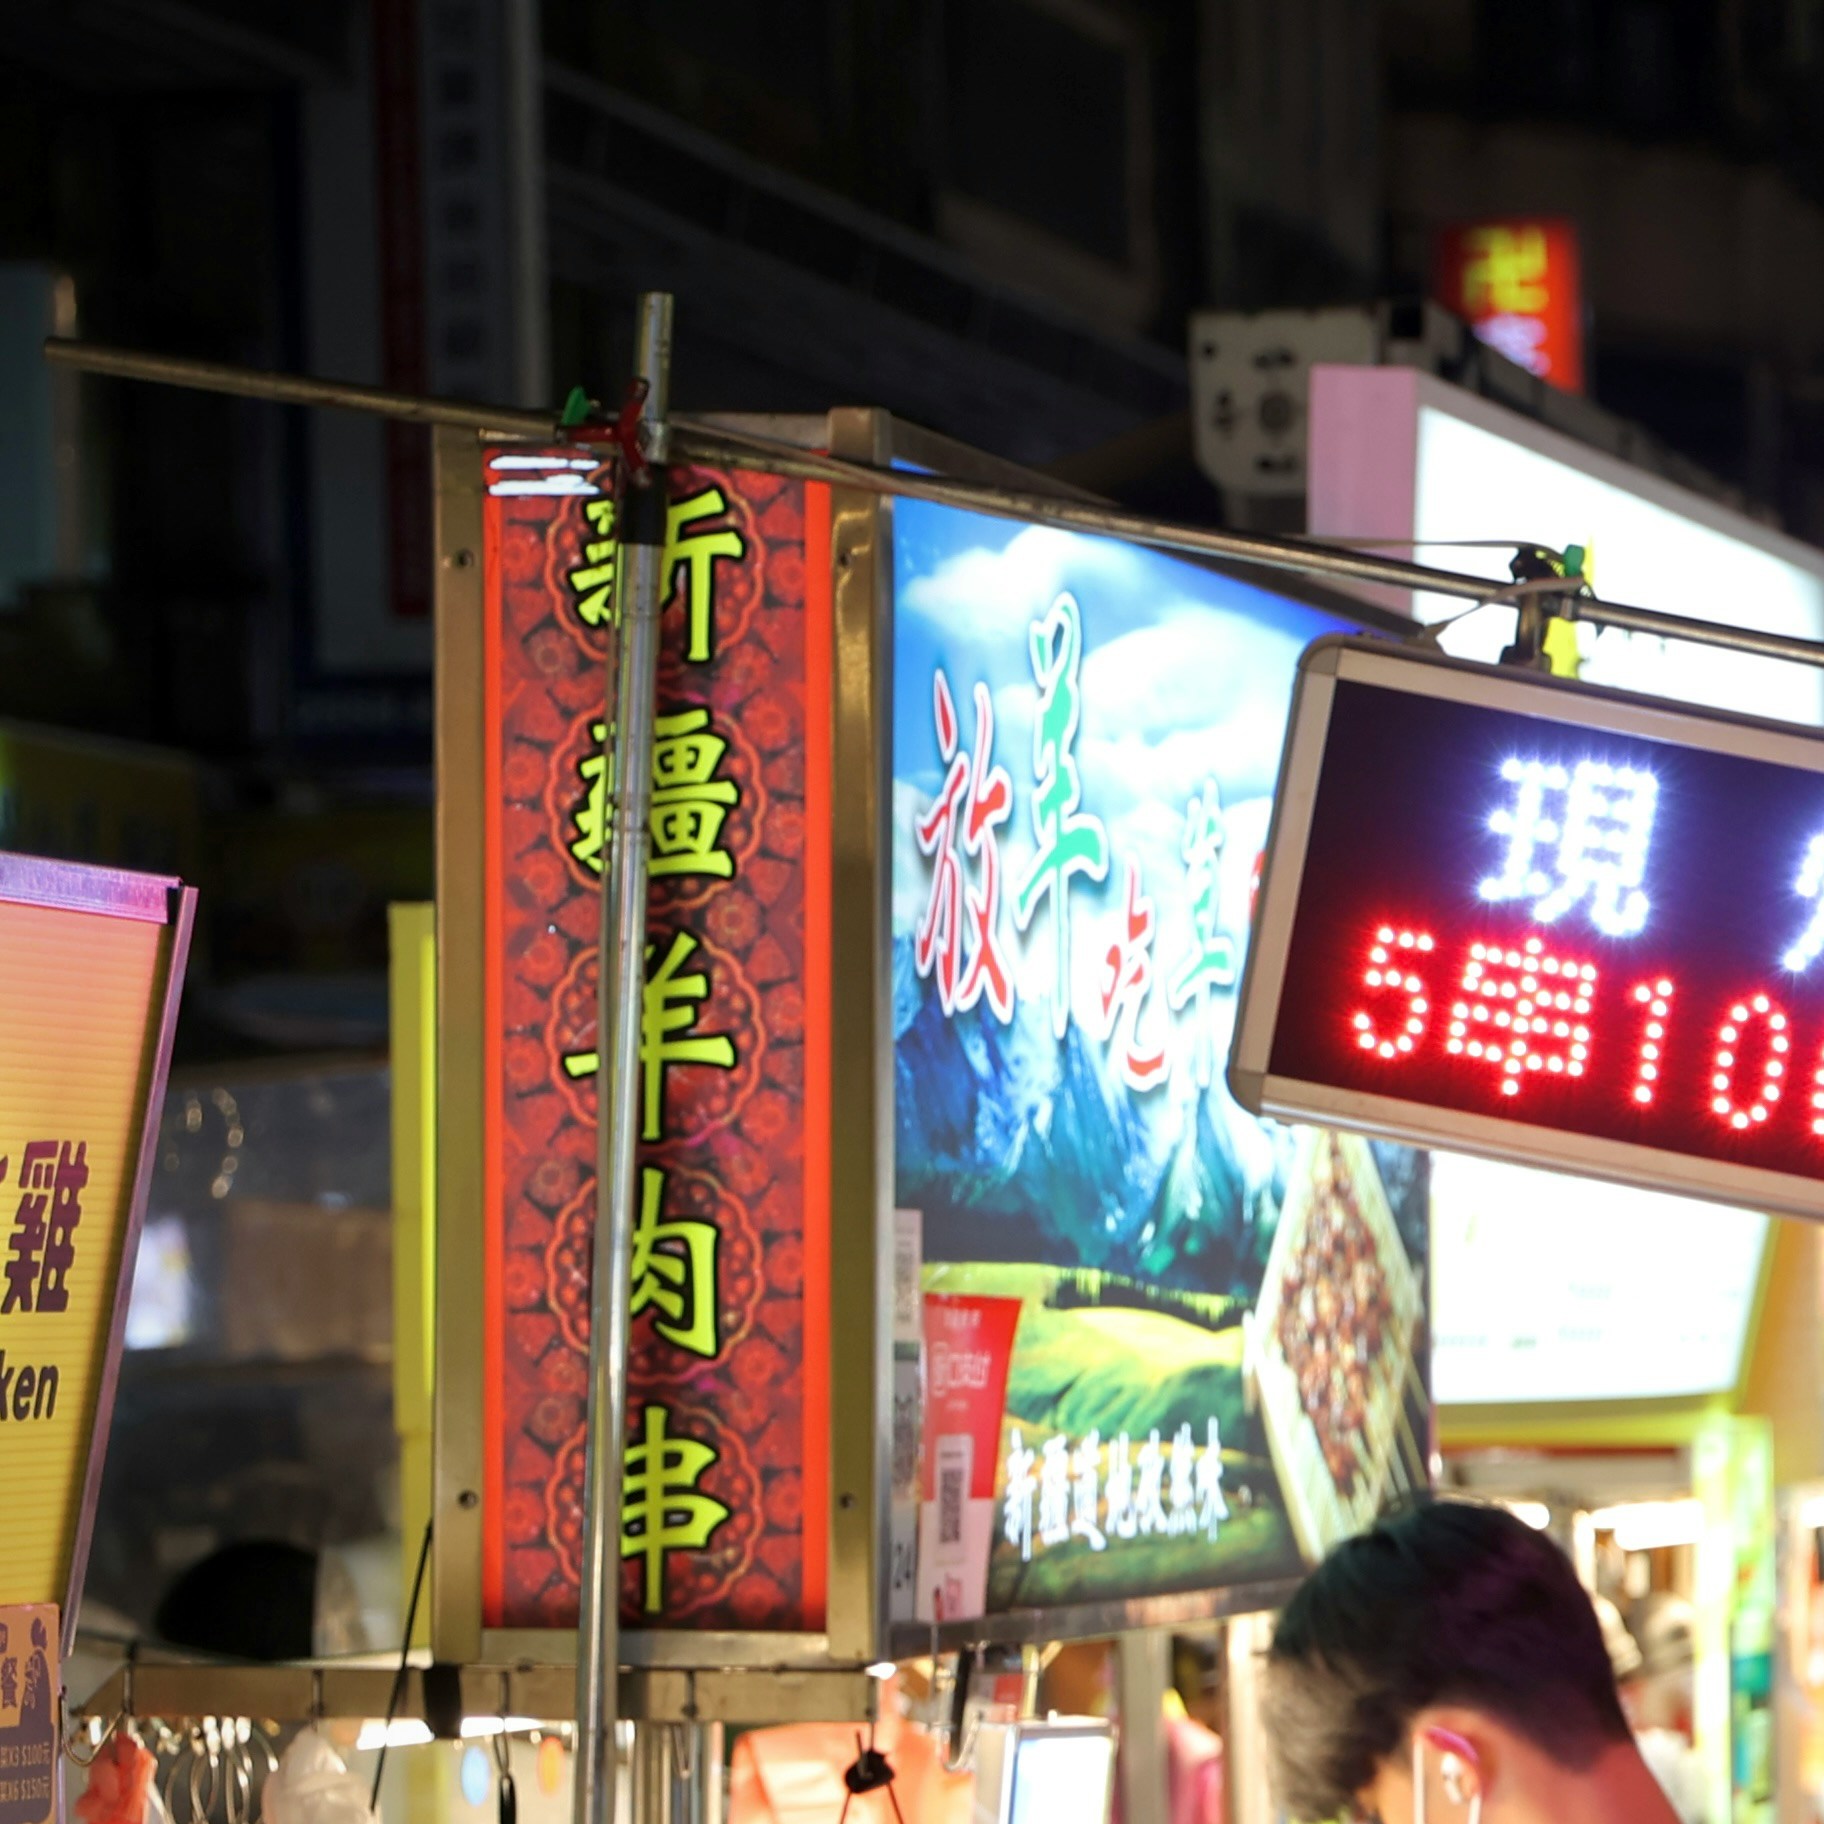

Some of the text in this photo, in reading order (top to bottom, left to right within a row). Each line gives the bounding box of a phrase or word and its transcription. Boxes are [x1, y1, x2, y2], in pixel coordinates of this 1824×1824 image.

[563, 488, 743, 1613] 新疆羊肉串
